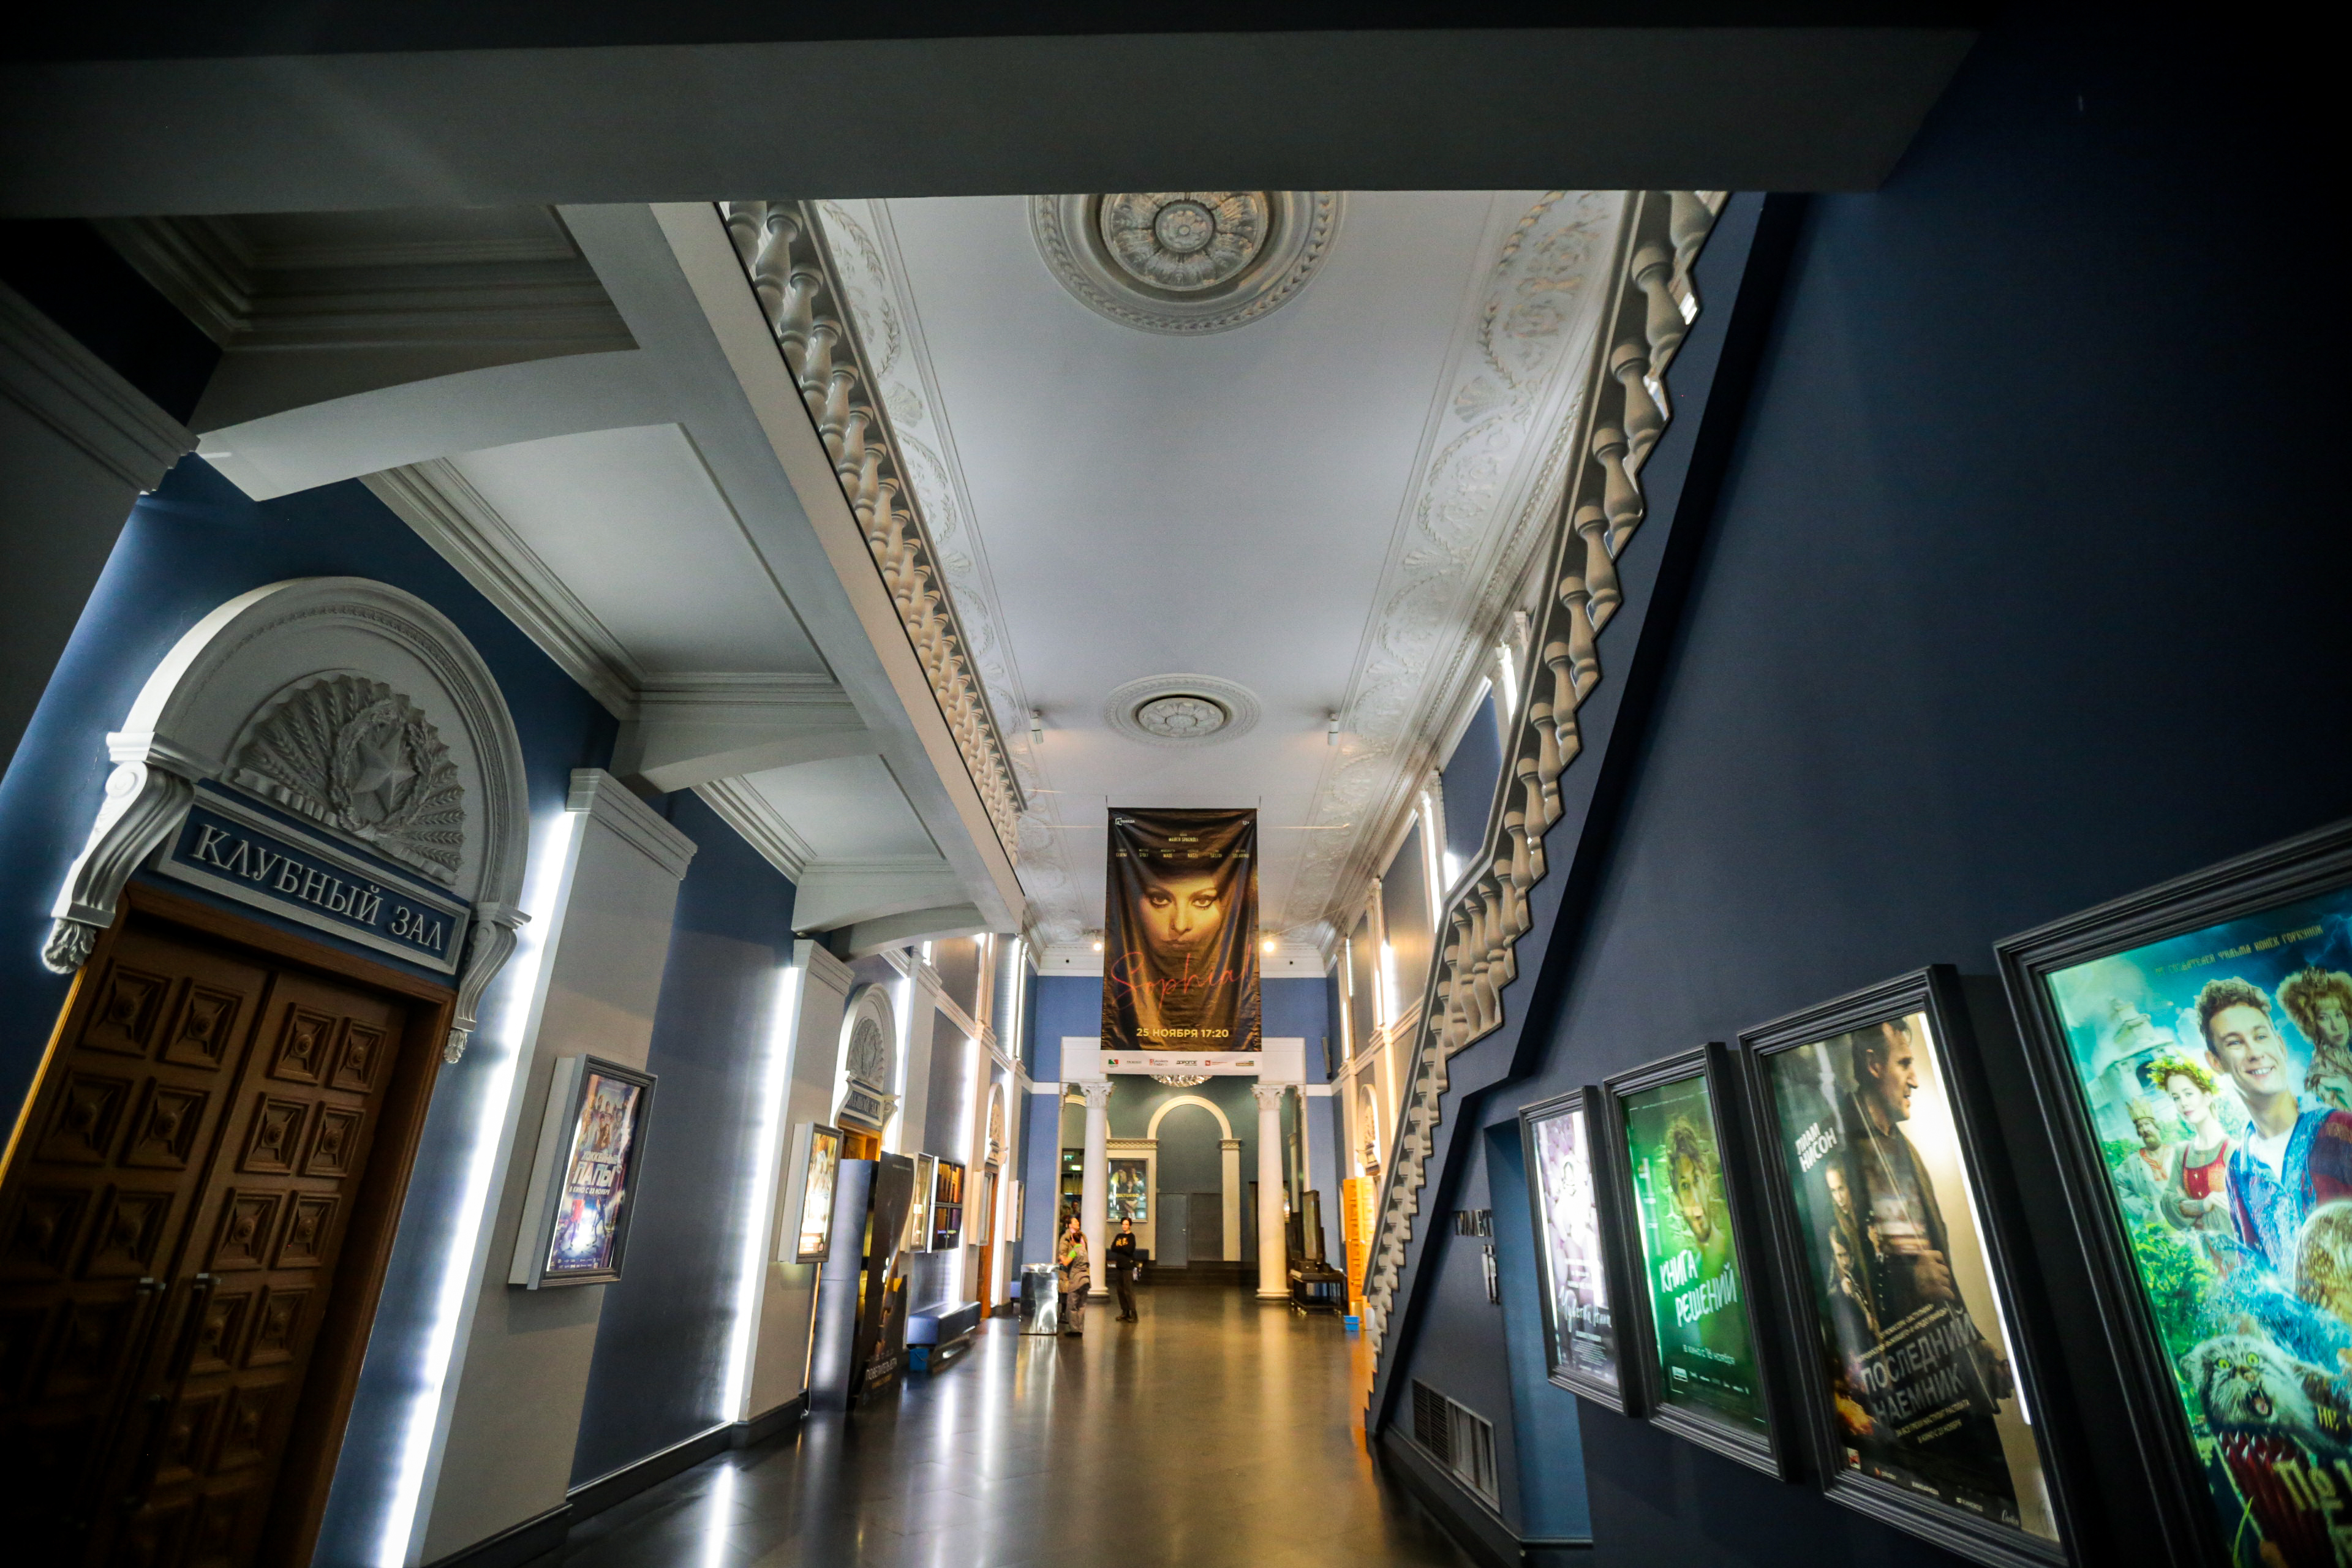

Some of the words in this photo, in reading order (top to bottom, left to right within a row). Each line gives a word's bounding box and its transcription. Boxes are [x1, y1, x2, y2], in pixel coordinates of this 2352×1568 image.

[189, 823, 383, 926] КЛУБНЫЙ
[390, 905, 442, 951] ЗАЛ
[2218, 944, 2252, 961] ФИЛЬМА
[1136, 1028, 1149, 1037] 25
[1152, 1028, 1198, 1038] НОЯБРЯ
[1200, 1029, 1229, 1038] 17:20
[1795, 1122, 1821, 1156] ЛИАМ
[1799, 1127, 1838, 1173] НИСОН
[571, 1161, 617, 1187] ПАПЫ
[1659, 1250, 1698, 1293] КНИГА
[1675, 1262, 1738, 1328] РЕШЕНИЙ
[1860, 1306, 1978, 1395] ПОСЛЕДНИЙ
[1872, 1363, 1966, 1423] НАЕМНИК
